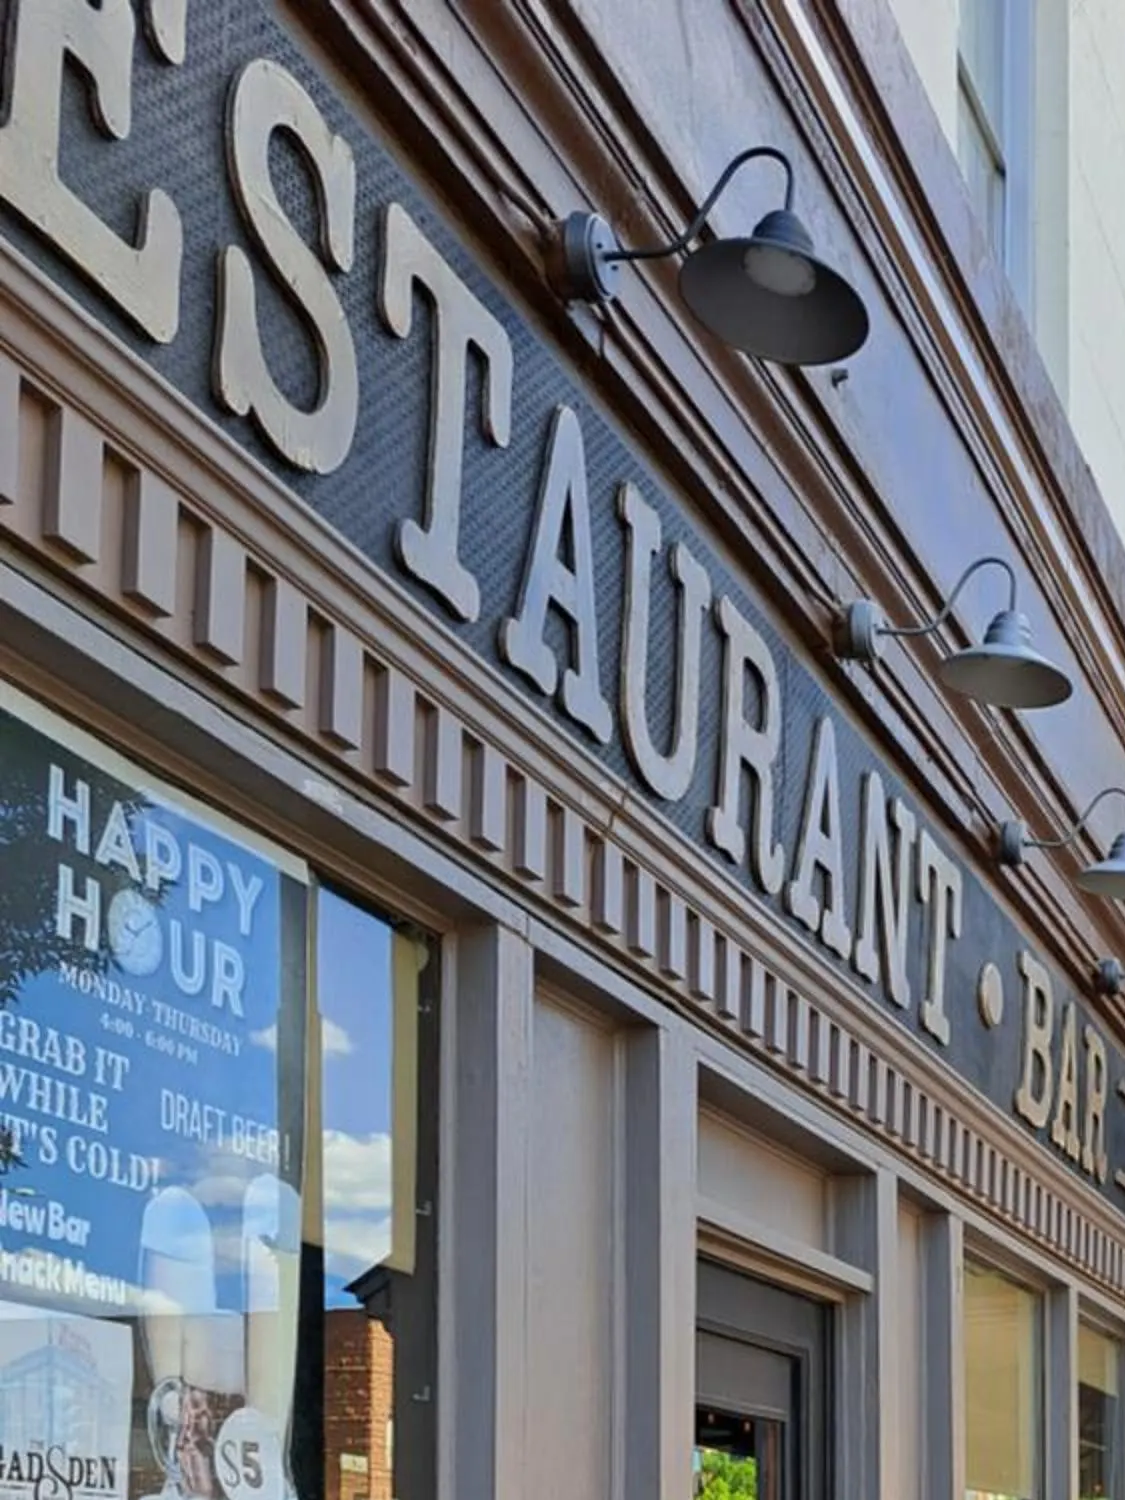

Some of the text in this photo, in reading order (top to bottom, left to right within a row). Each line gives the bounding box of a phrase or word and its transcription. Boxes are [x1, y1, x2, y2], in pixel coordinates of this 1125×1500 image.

[46, 762, 265, 937] HAPPY
[0, 1010, 131, 1092] GRAB IT
[1013, 949, 1108, 1185] BAR
[0, 1062, 109, 1134] WHILE
[160, 1087, 227, 1148] DRAFT
[0, 1111, 161, 1197] T'S COLD!
[47, 1199, 91, 1248] Bar
[0, 1248, 126, 1306] nack Menu
